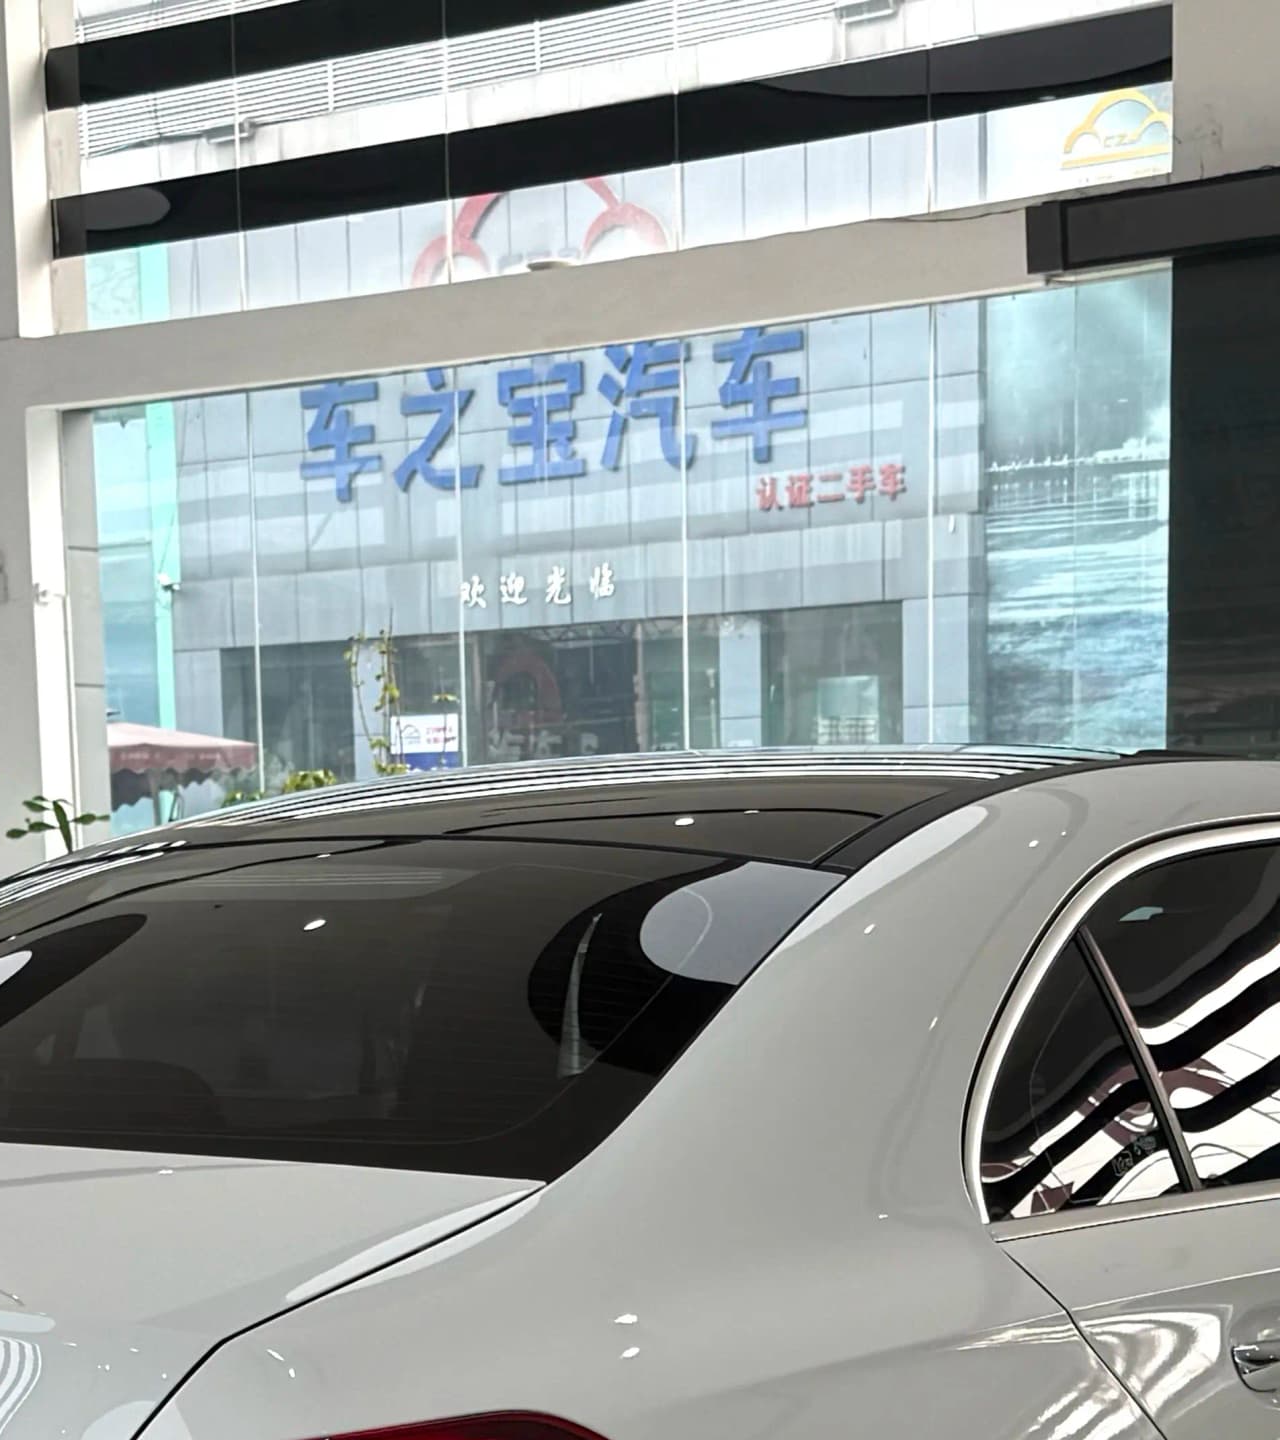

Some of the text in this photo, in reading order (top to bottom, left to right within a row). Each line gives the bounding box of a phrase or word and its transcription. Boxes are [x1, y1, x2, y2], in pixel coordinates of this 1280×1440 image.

[299, 326, 808, 501] 车之宝汽车
[756, 463, 908, 512] 认证二手车
[460, 562, 615, 609] 欢迎光临
